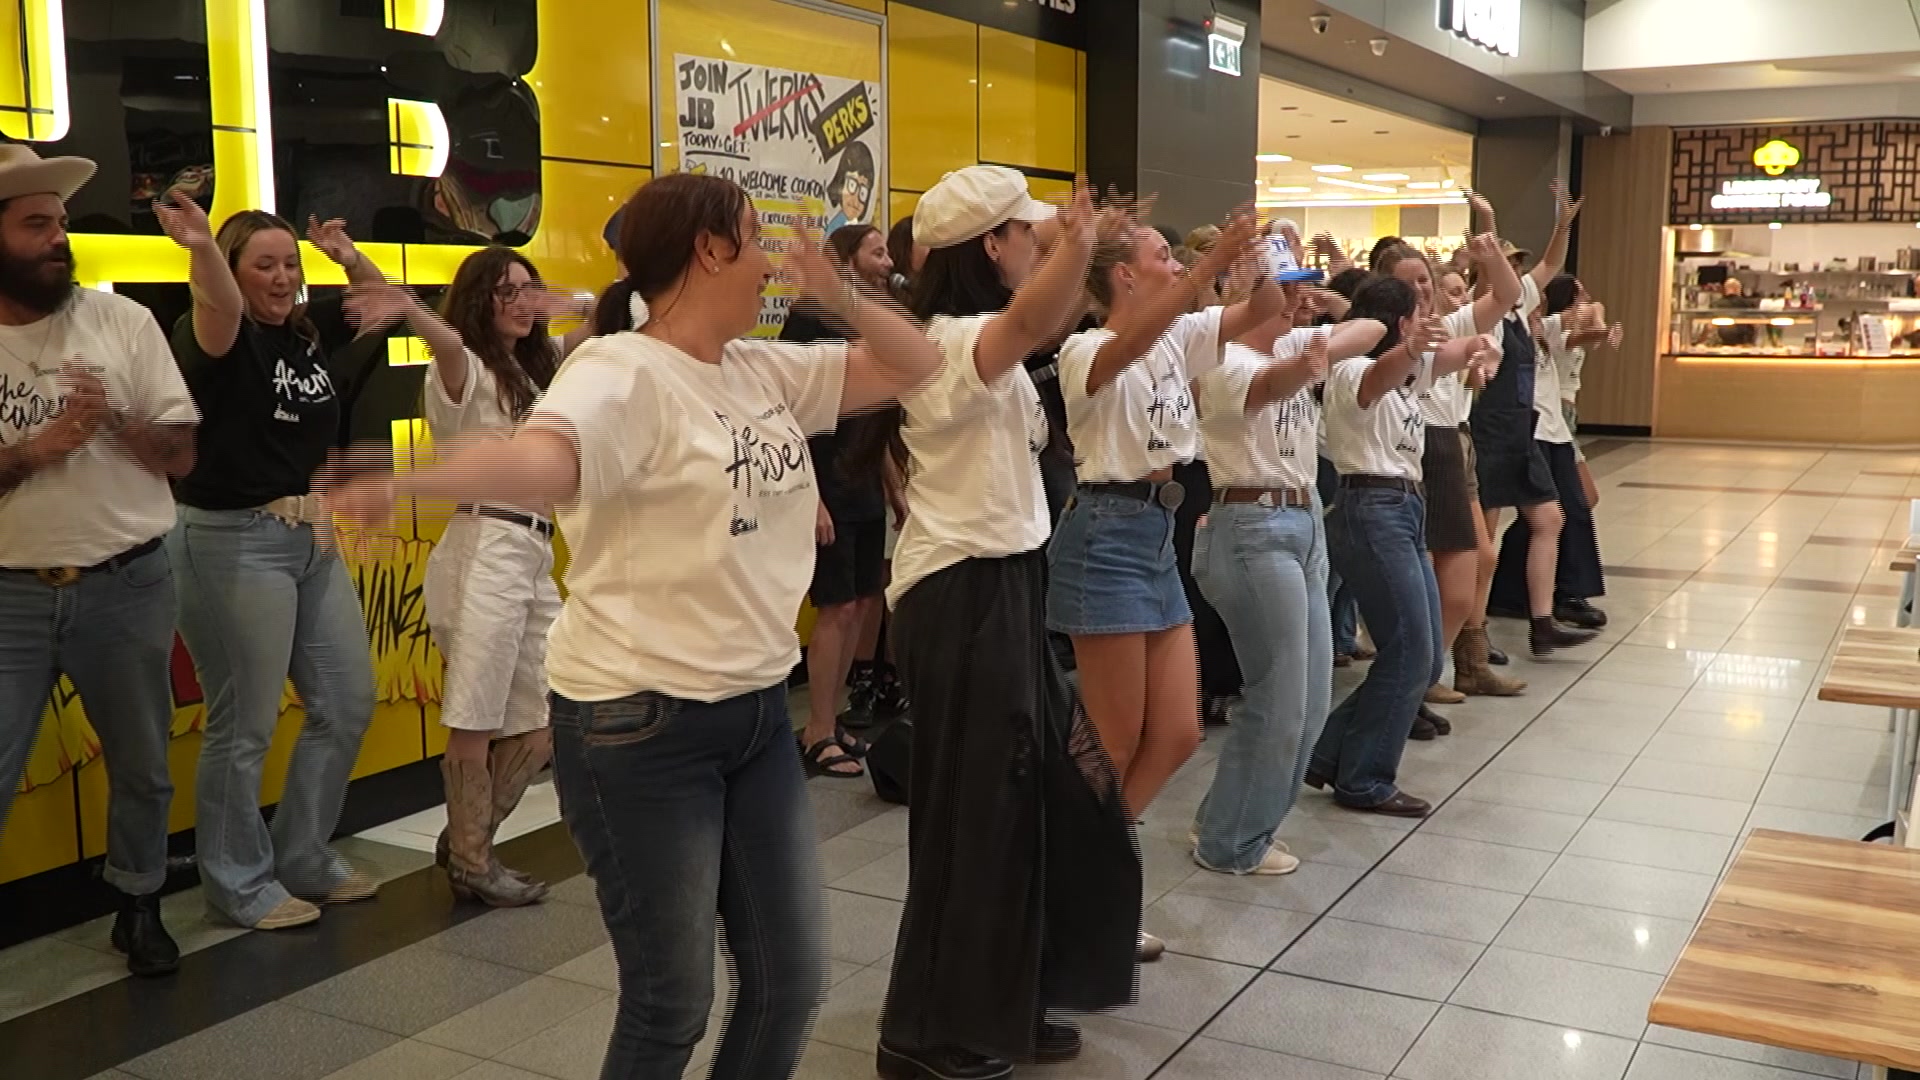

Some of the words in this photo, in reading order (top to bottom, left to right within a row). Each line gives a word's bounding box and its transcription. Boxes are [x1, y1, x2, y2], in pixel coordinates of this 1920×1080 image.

[679, 59, 728, 94] JOIN
[728, 67, 826, 141] TWERKS
[821, 95, 869, 149] PERKS
[679, 97, 715, 130] JB
[738, 169, 787, 193] WELCOME
